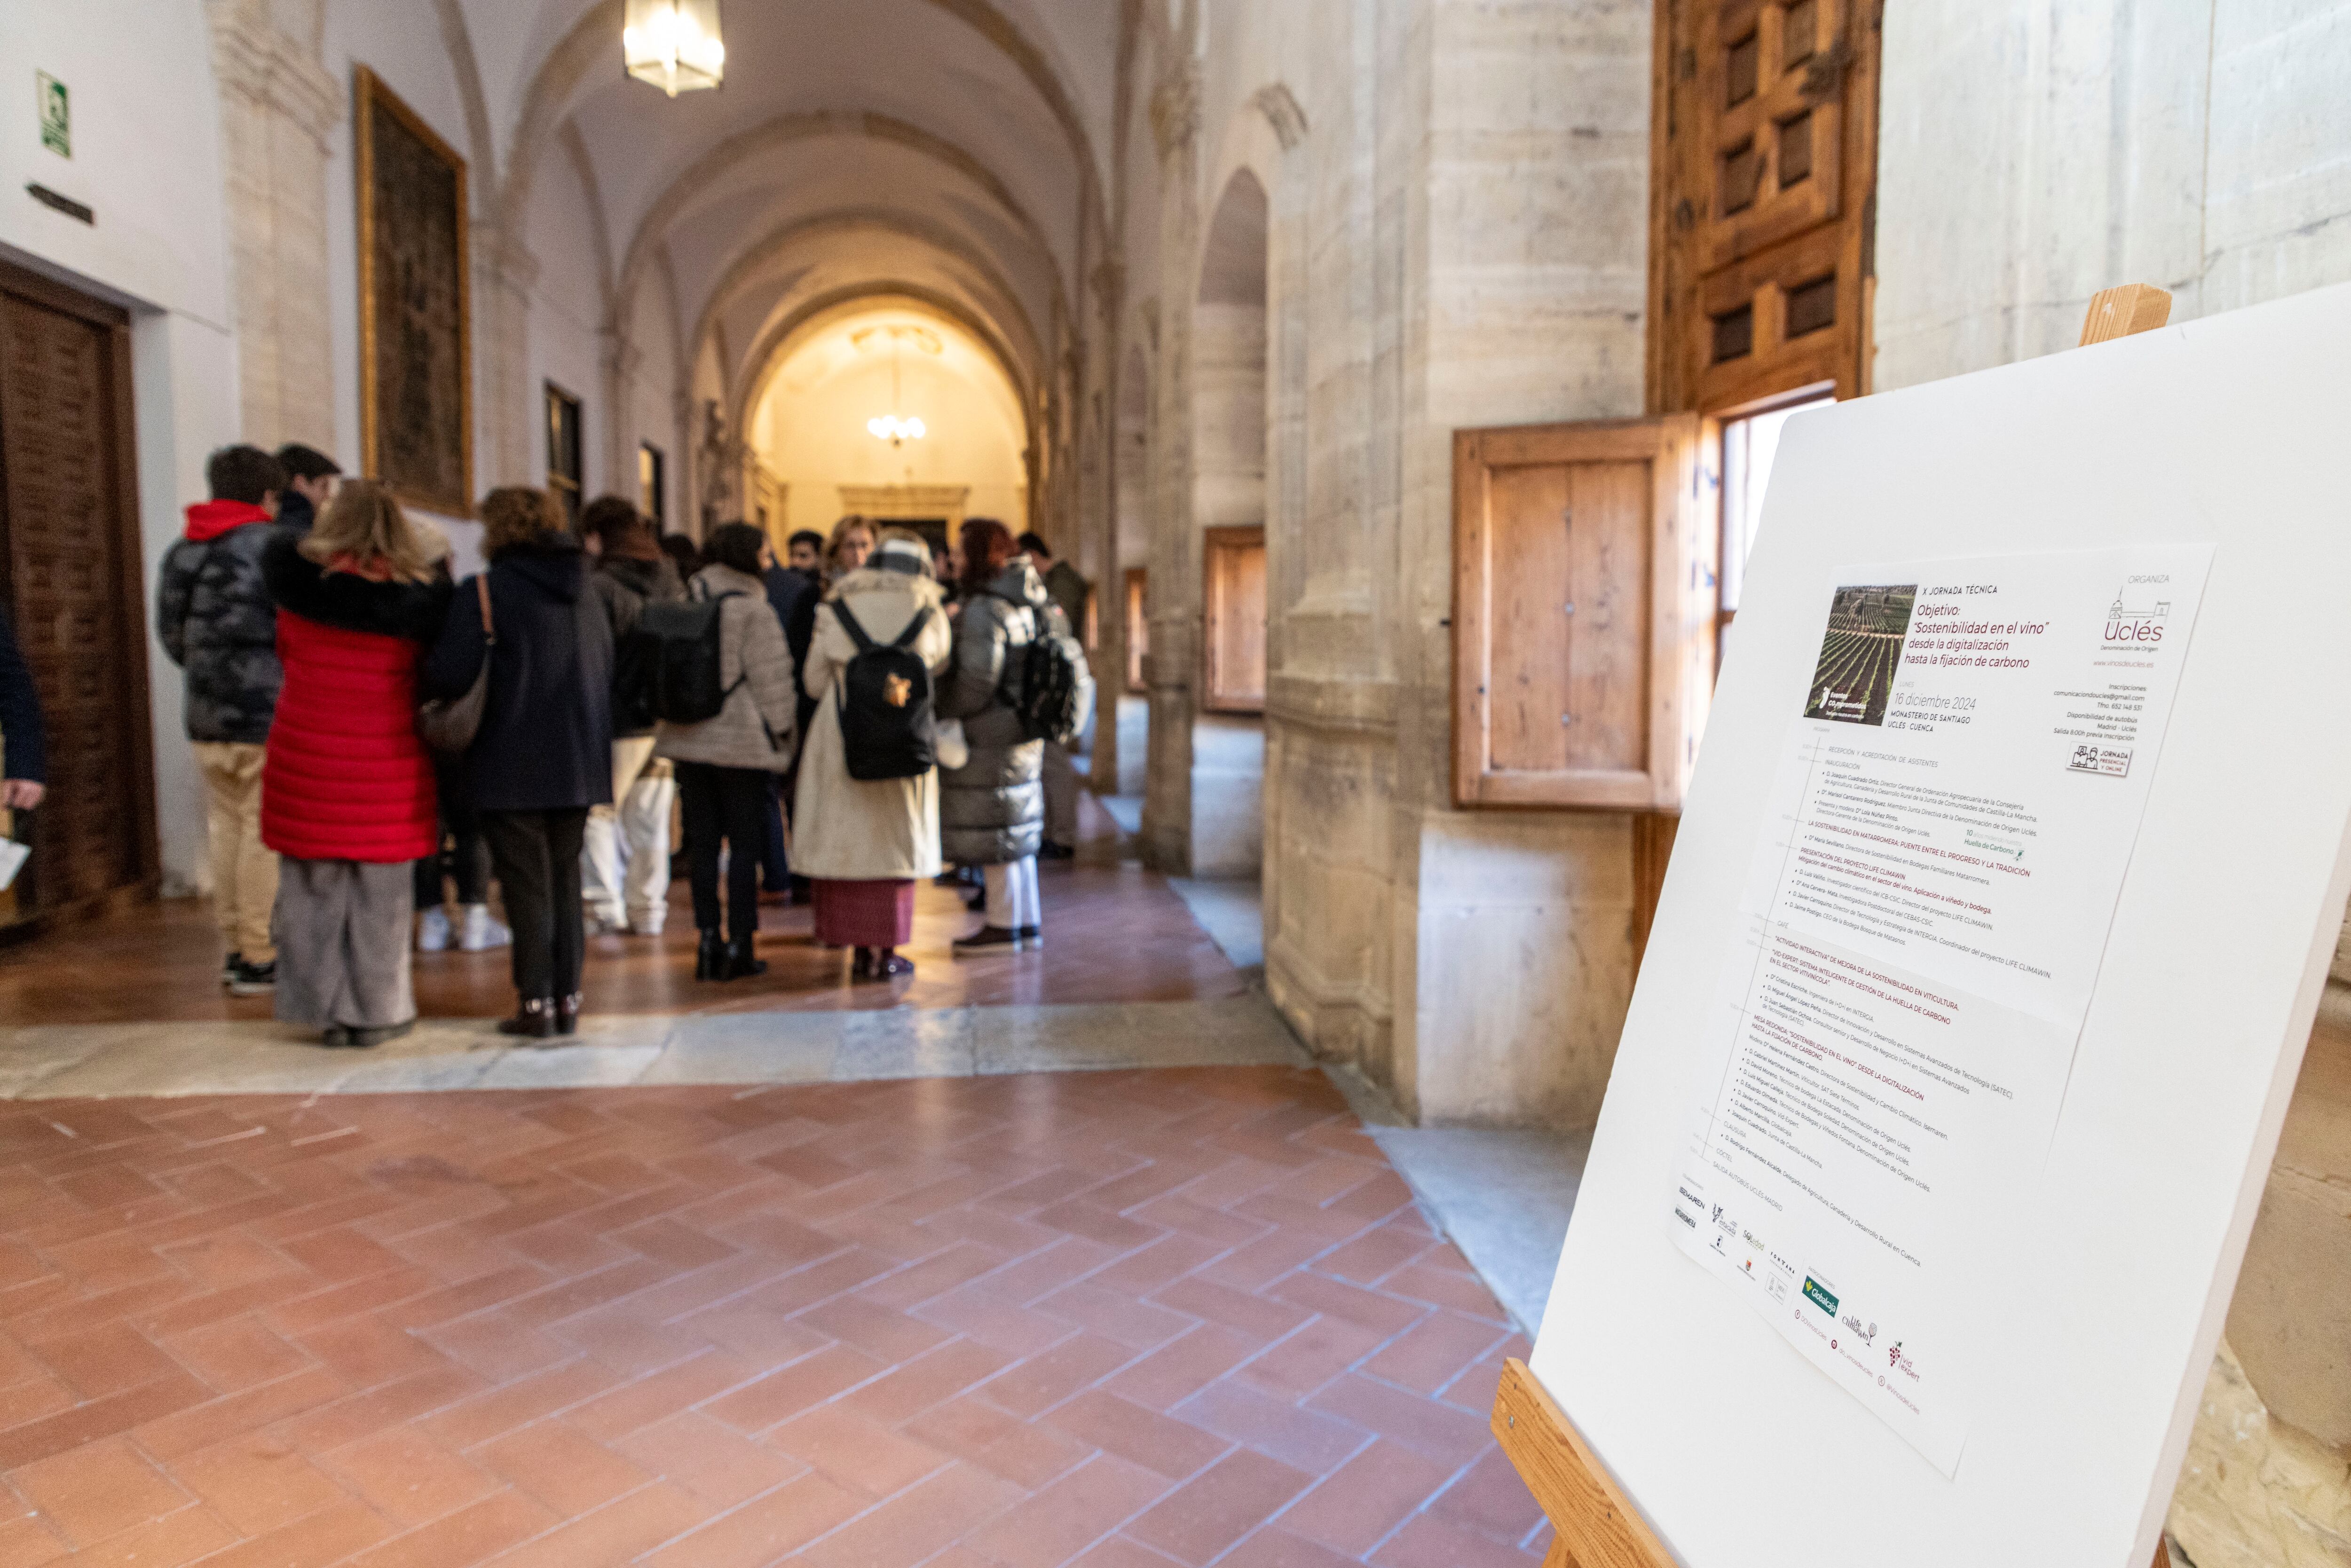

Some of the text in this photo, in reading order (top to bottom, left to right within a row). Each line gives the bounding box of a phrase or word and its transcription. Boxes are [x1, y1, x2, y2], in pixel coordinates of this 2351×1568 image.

[2128, 574, 2170, 584] ORGANIZA
[1929, 586, 1962, 595] JORNADA
[1965, 584, 1997, 594] TÉCNICA
[1990, 624, 2004, 634] en
[2006, 621, 2018, 634] el
[2104, 620, 2163, 641] Uclés
[1909, 638, 2009, 652] desde la digitalización
[1904, 653, 2029, 668] hasta la fijación de carbono
[1895, 693, 1976, 710] 16 diciembre 2024
[1890, 710, 1929, 720] MONASTERIO
[1939, 714, 1971, 724] SANTIAGO
[2066, 711, 2105, 720] Disponibilidad
[1887, 721, 1933, 732] UCLÉS CUENCA
[2100, 750, 2128, 759] JORNADA
[1814, 821, 1852, 835] SOSTENIBILIDAD
[1900, 841, 1921, 851] PUENTE
[1921, 846, 1940, 856] ENTRE
[1947, 852, 1980, 865] PROGRESO
[1996, 863, 2031, 877] TRADICIÓN
[1964, 838, 1981, 848] Huella
[1989, 843, 2014, 855] Carbono
[1800, 847, 1834, 861] PRESENTACIÓN
[1843, 858, 1869, 870] PROYECTO
[1879, 868, 1906, 880] CLIMAWIN
[1798, 855, 1820, 866] Mitigación
[1827, 864, 1844, 873] cambio
[1844, 868, 1865, 879] climático
[1877, 877, 1893, 886] sector
[1913, 887, 1941, 900] Aplicación
[1945, 896, 1964, 906] viñedo
[1782, 961, 1799, 973] SECTOR
[1837, 959, 1856, 971] MEJORA
[1872, 972, 1914, 993] SOSTENIBILIDAD
[1914, 988, 1923, 996] EN
[1799, 959, 1818, 971] SISTEMA
[1818, 967, 1848, 984] INTELIGENTE
[1855, 982, 1877, 995] GESTIÓN
[1877, 990, 1885, 999] DE
[1885, 993, 1892, 1001] LA
[1892, 996, 1913, 1010] HUELLA
[1913, 1004, 1922, 1014] DE
[1922, 1009, 1951, 1025] CARBONO
[1751, 1022, 1765, 1032] HASTA
[1771, 1031, 1791, 1046] FIJACIÓN
[1791, 1041, 1799, 1049] DE
[1753, 1014, 1765, 1024] MESA
[1828, 1049, 1836, 1057] EN
[1857, 1063, 1875, 1077] DESDE
[1874, 1072, 1881, 1080] LA
[1881, 1075, 1925, 1101] DIGITALIZACIÓN
[1811, 1287, 1837, 1315] Globalcaja
[1850, 1315, 1862, 1329] Life
[1903, 1357, 1913, 1368] vid
[1901, 1364, 1920, 1382] expert
